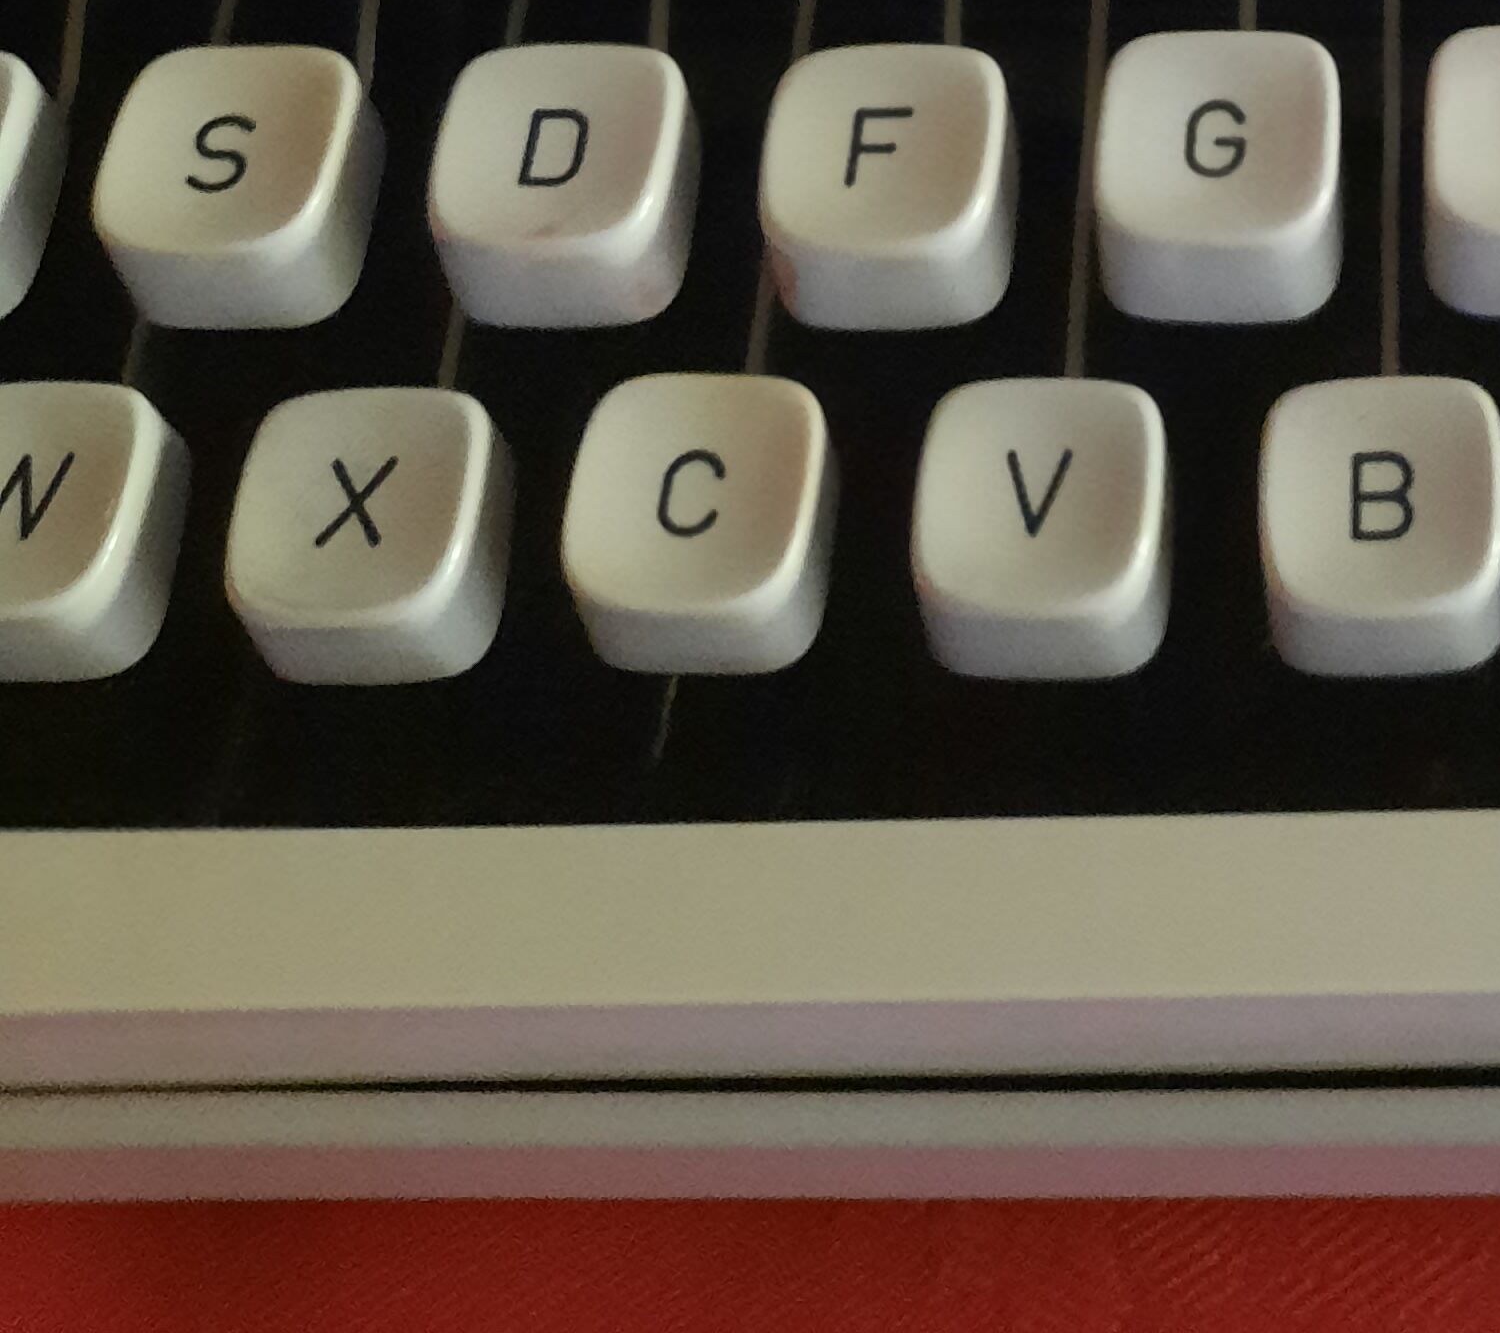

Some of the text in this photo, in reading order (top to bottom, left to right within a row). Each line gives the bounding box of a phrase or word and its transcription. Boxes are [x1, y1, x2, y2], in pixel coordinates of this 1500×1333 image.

[185, 114, 257, 193] S
[518, 108, 589, 187] D
[844, 107, 914, 188] F
[1183, 99, 1248, 177] G
[314, 456, 399, 550] X
[656, 449, 727, 537] C
[1007, 448, 1073, 538] V
[1349, 450, 1415, 540] B
